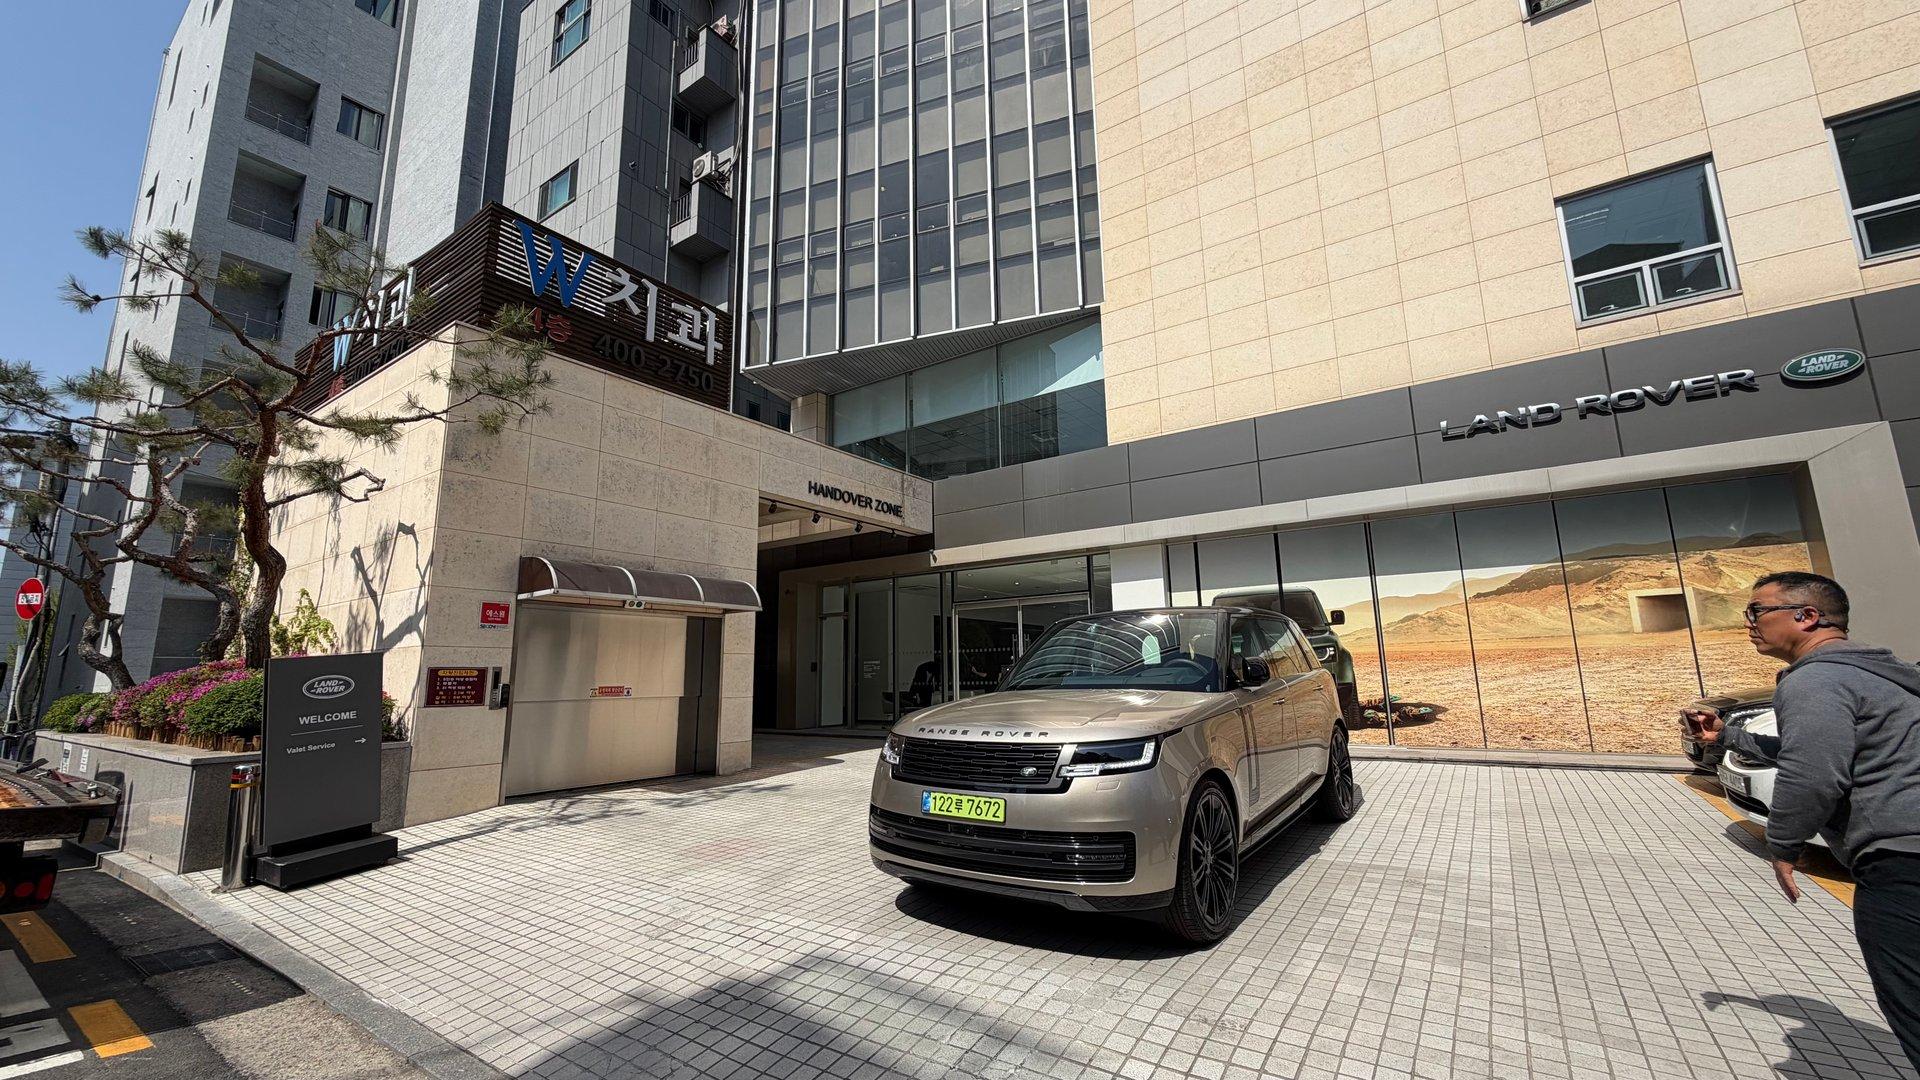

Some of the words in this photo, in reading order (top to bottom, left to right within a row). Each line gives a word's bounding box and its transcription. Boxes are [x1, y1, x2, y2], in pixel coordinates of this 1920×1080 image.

[593, 333, 714, 393] 400-2750
[1801, 354, 1837, 367] LAND
[1805, 360, 1849, 374] ROVER
[1440, 402, 1562, 442] LAND
[1575, 368, 1760, 421] ROVER
[808, 480, 873, 510] HANDOVER
[874, 499, 903, 518] ZONE
[313, 680, 339, 688] LAND
[315, 685, 346, 694] ROVER
[299, 710, 357, 725] WELCOME
[918, 727, 969, 736] RANGE
[981, 730, 1049, 738] ROVER
[286, 746, 306, 755] Valet
[307, 742, 336, 751] Service
[932, 795, 962, 814] 122루
[966, 798, 1001, 818] 7672
